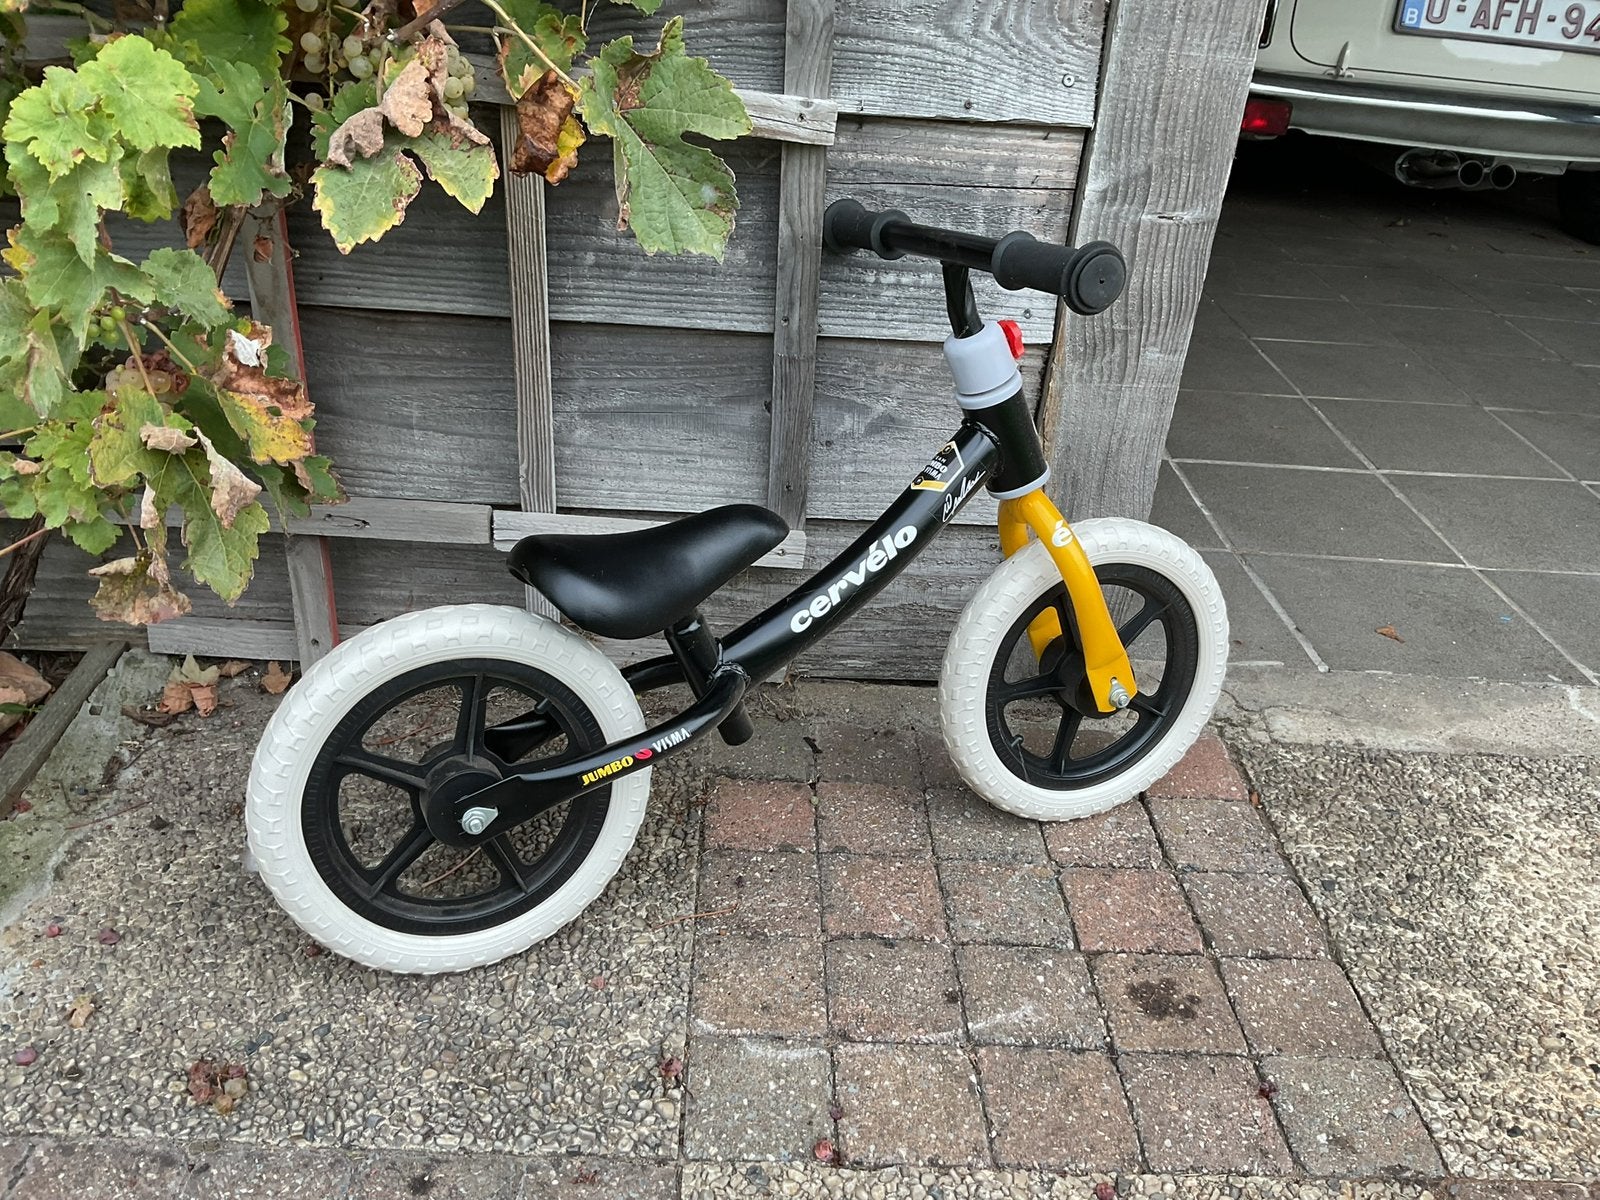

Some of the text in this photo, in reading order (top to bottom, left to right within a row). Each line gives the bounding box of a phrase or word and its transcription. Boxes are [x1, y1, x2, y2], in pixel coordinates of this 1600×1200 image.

[1405, 10, 1419, 25] B
[790, 525, 918, 634] cervélo
[581, 727, 691, 786] JUMBO VISMA
